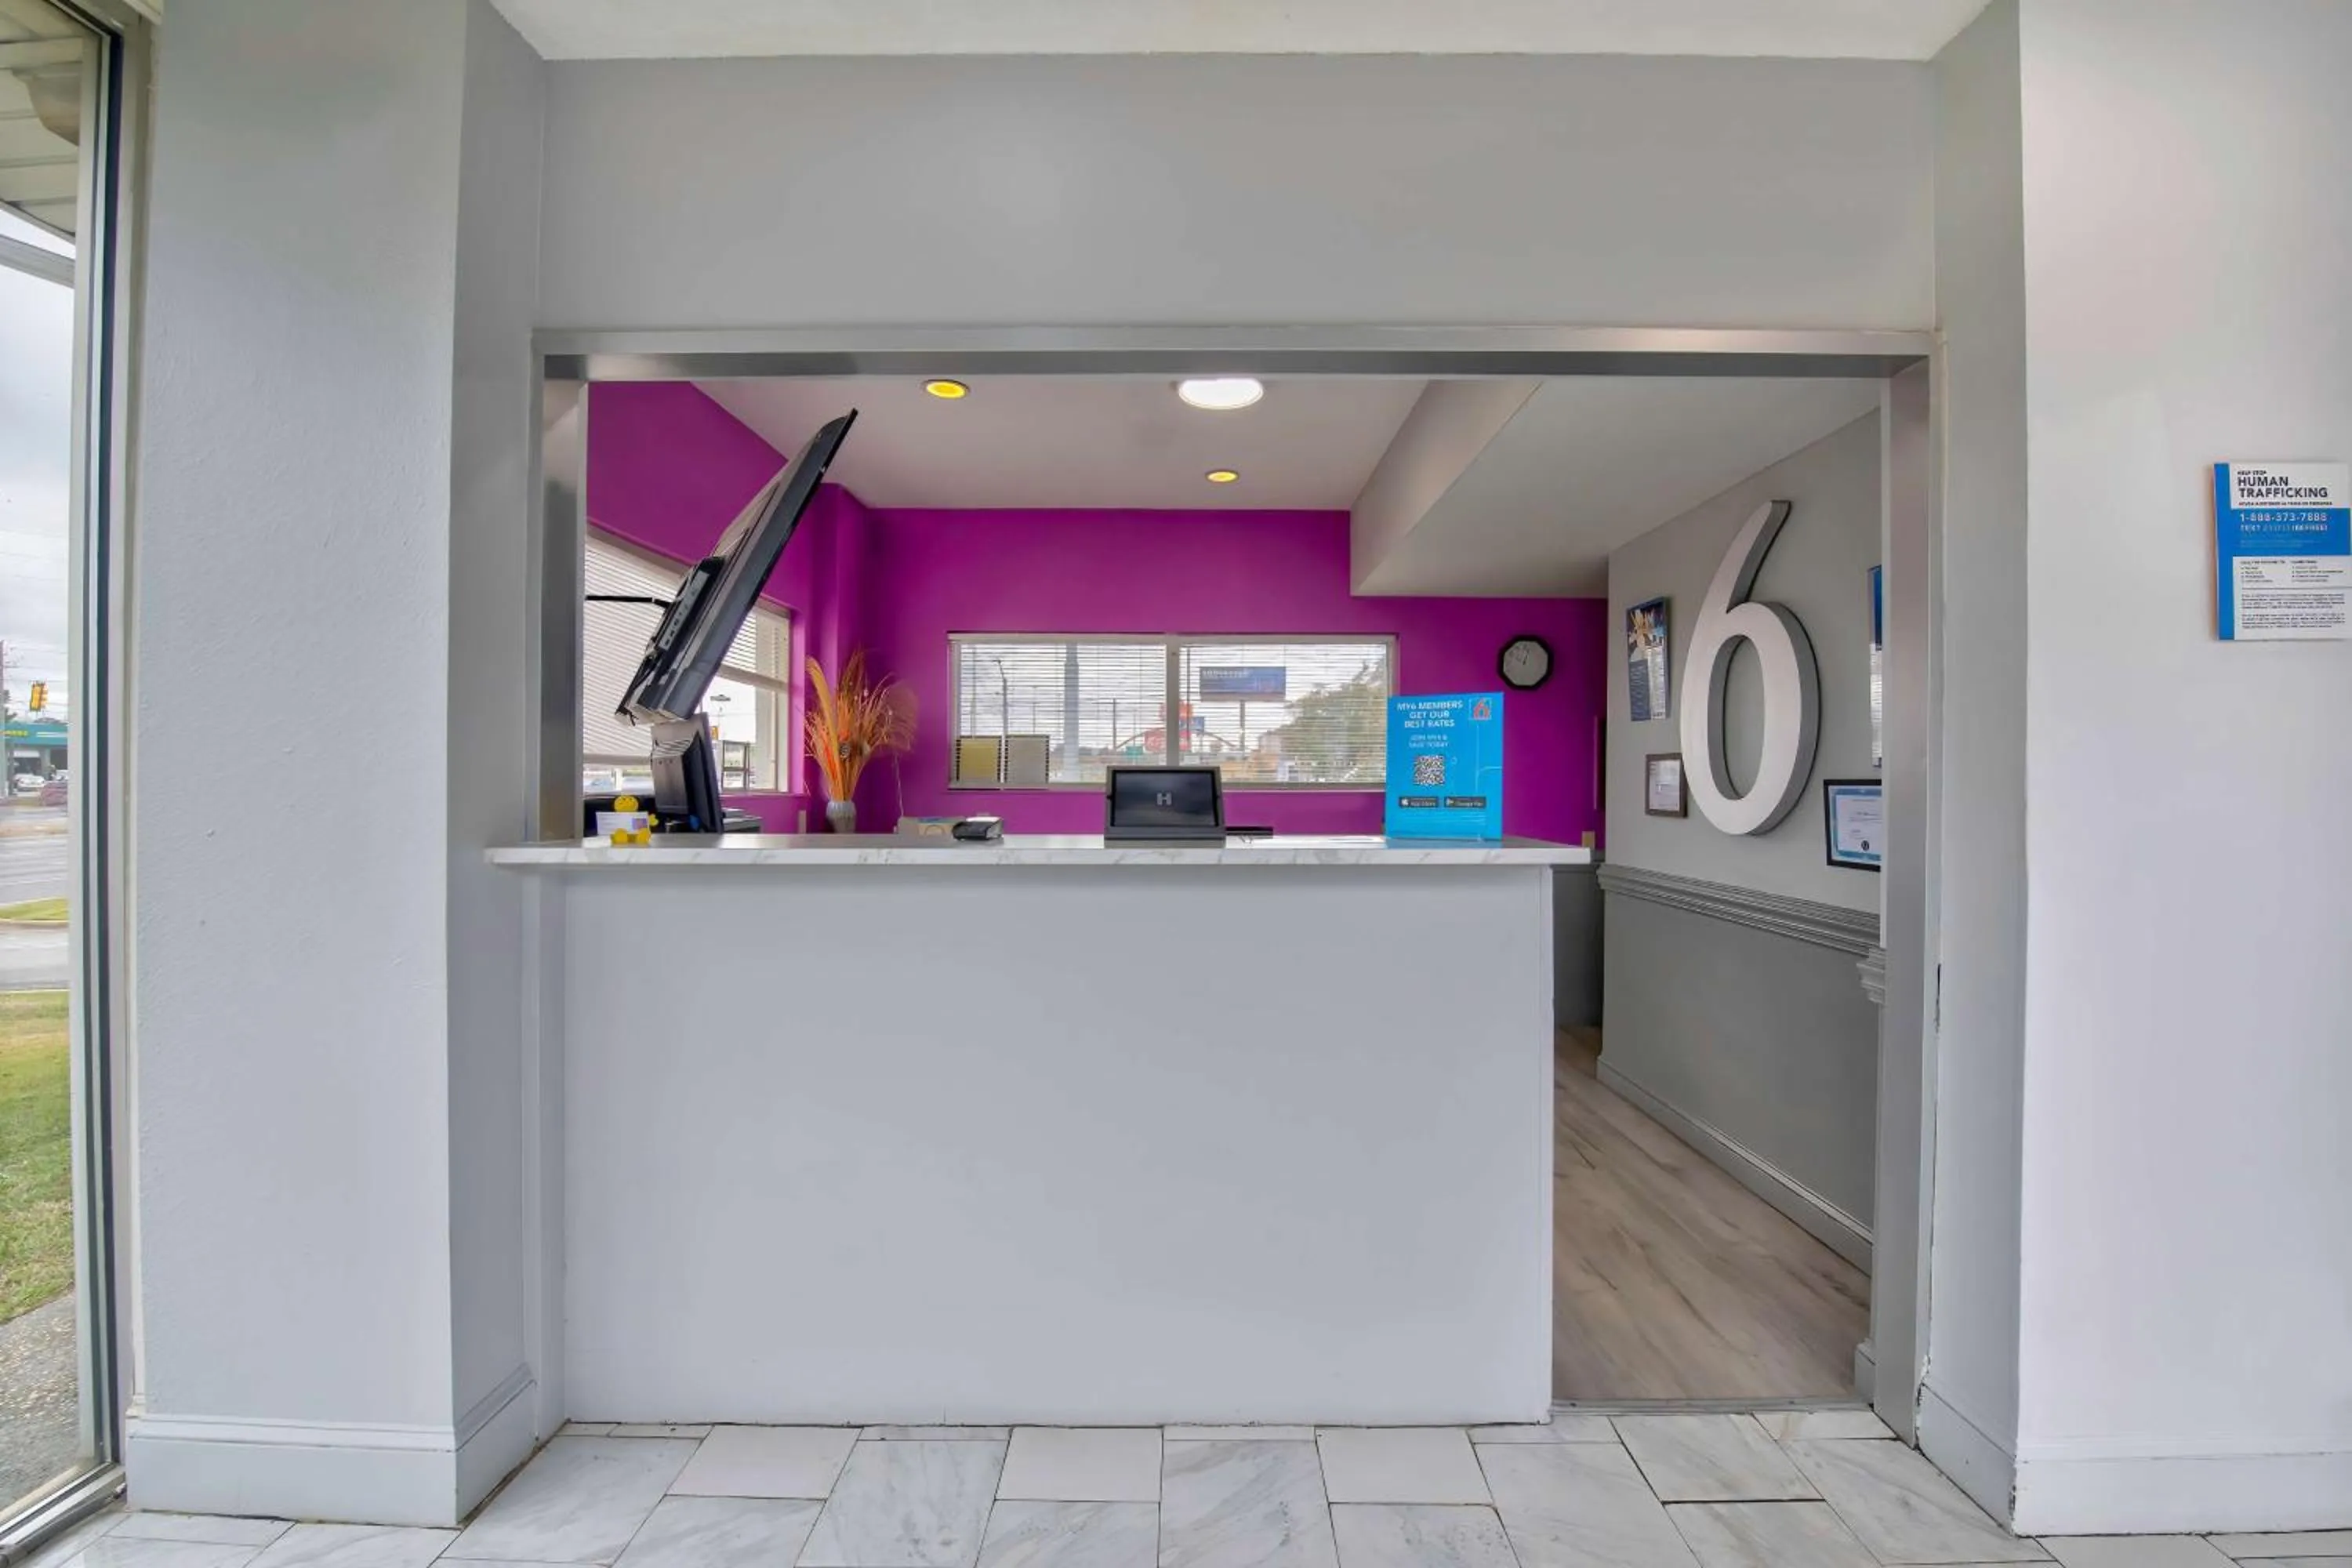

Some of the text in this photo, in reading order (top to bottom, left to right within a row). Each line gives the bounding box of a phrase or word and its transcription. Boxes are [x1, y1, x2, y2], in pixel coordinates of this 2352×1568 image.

[2238, 477, 2288, 487] HUMAN
[2239, 487, 2328, 498] TRAFFICKING
[1679, 499, 1820, 836] 6
[1418, 699, 1464, 710] MEMBERS
[1429, 710, 1450, 719] OUR
[1427, 719, 1455, 728] RATES
[1156, 792, 1172, 806] H
